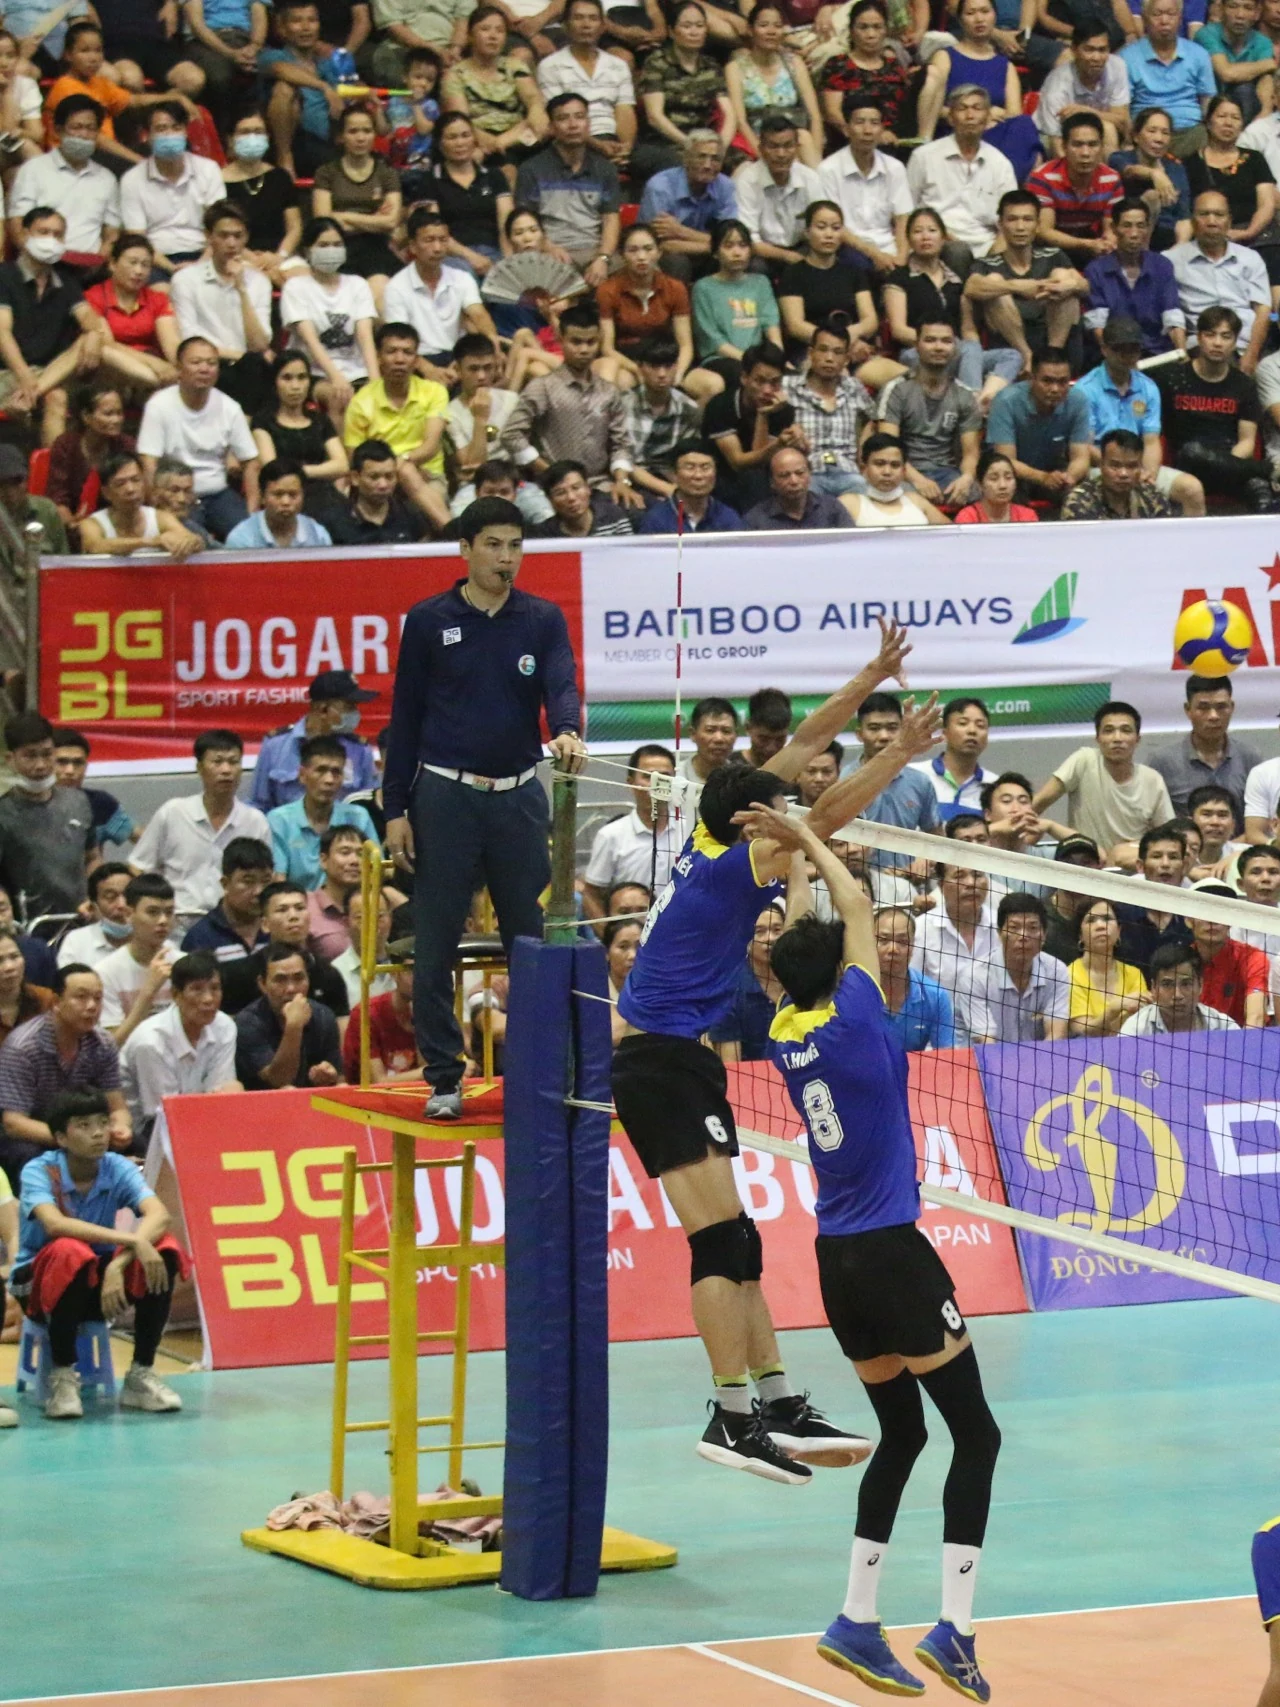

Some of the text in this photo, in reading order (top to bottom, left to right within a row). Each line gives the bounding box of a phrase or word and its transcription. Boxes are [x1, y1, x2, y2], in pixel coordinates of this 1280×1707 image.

[60, 610, 164, 662] JG
[604, 597, 1014, 639] BAMBOO AIRWAYS
[176, 612, 408, 682] JOGAR
[604, 645, 768, 663] MEMBER O FLC GROUP
[59, 670, 164, 721] BL
[176, 686, 312, 708] SPORT FASHIO
[704, 1115, 728, 1143] 6
[803, 1078, 845, 1152] 8
[927, 1223, 991, 1248] APAN
[940, 1299, 962, 1330] 8
